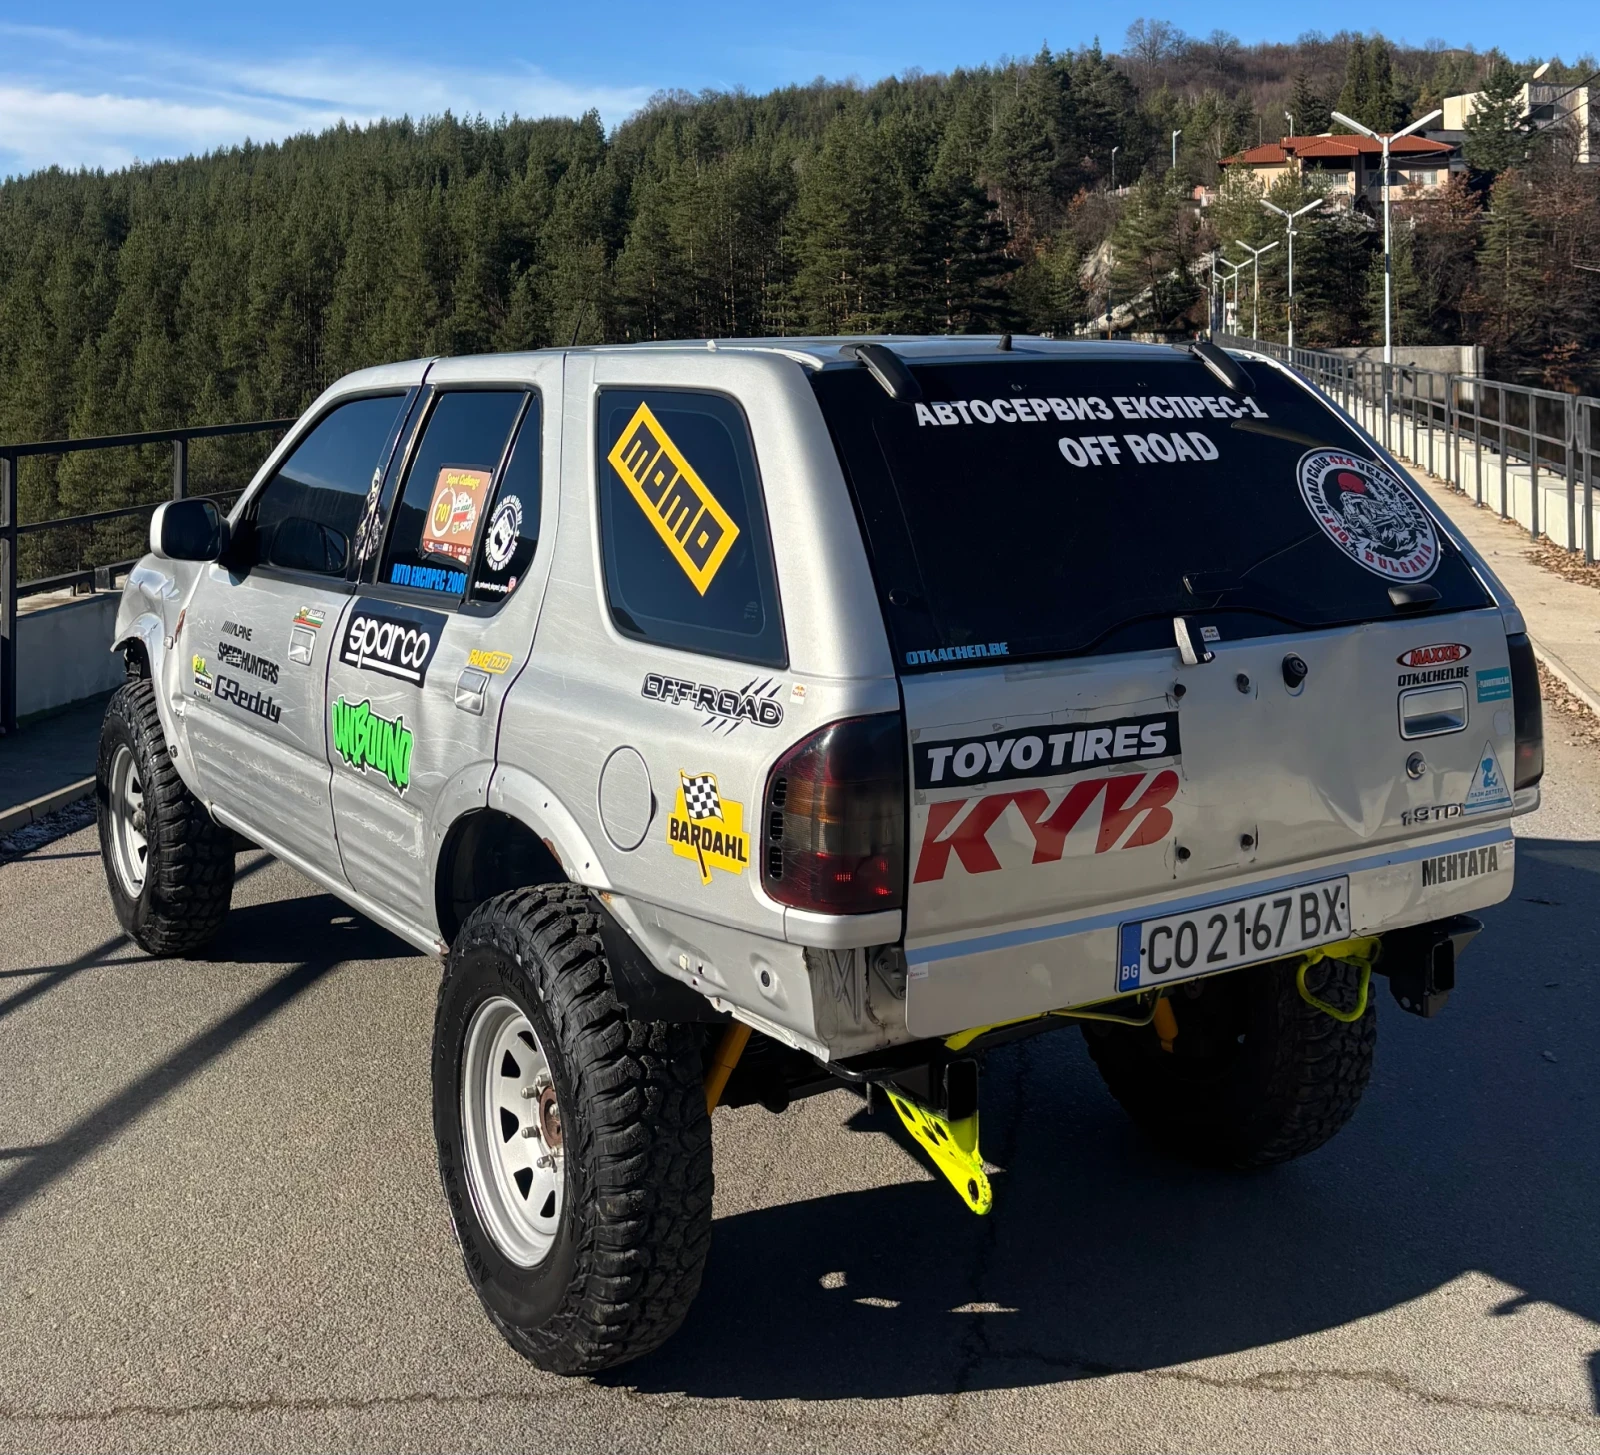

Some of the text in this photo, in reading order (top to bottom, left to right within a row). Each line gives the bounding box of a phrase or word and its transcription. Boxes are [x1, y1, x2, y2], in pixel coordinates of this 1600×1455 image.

[914, 396, 1270, 426] АВТОСЕРВИЗ ЕКСПРЕС-1
[1058, 431, 1219, 467] OFF ROAD
[1307, 457, 1331, 479] CLUB
[436, 503, 450, 522] 701
[1307, 478, 1330, 515] ROAD
[1355, 460, 1428, 531] VELINGRAD
[1321, 515, 1349, 543] OFF
[1365, 543, 1432, 573] BULGARIA
[410, 566, 447, 590] ЕКСПРЕС
[349, 616, 430, 668] sparco
[1409, 644, 1461, 666] MAXXIS
[641, 672, 784, 729] OFF-ROAD
[927, 722, 1167, 782] TOYO TIRES
[670, 817, 748, 862] BARDAHL
[912, 769, 1180, 885] KYB
[1422, 845, 1499, 887] МЕНТАТА
[1206, 896, 1293, 964] 2167
[1300, 885, 1343, 941] BX
[1121, 963, 1139, 981] BG
